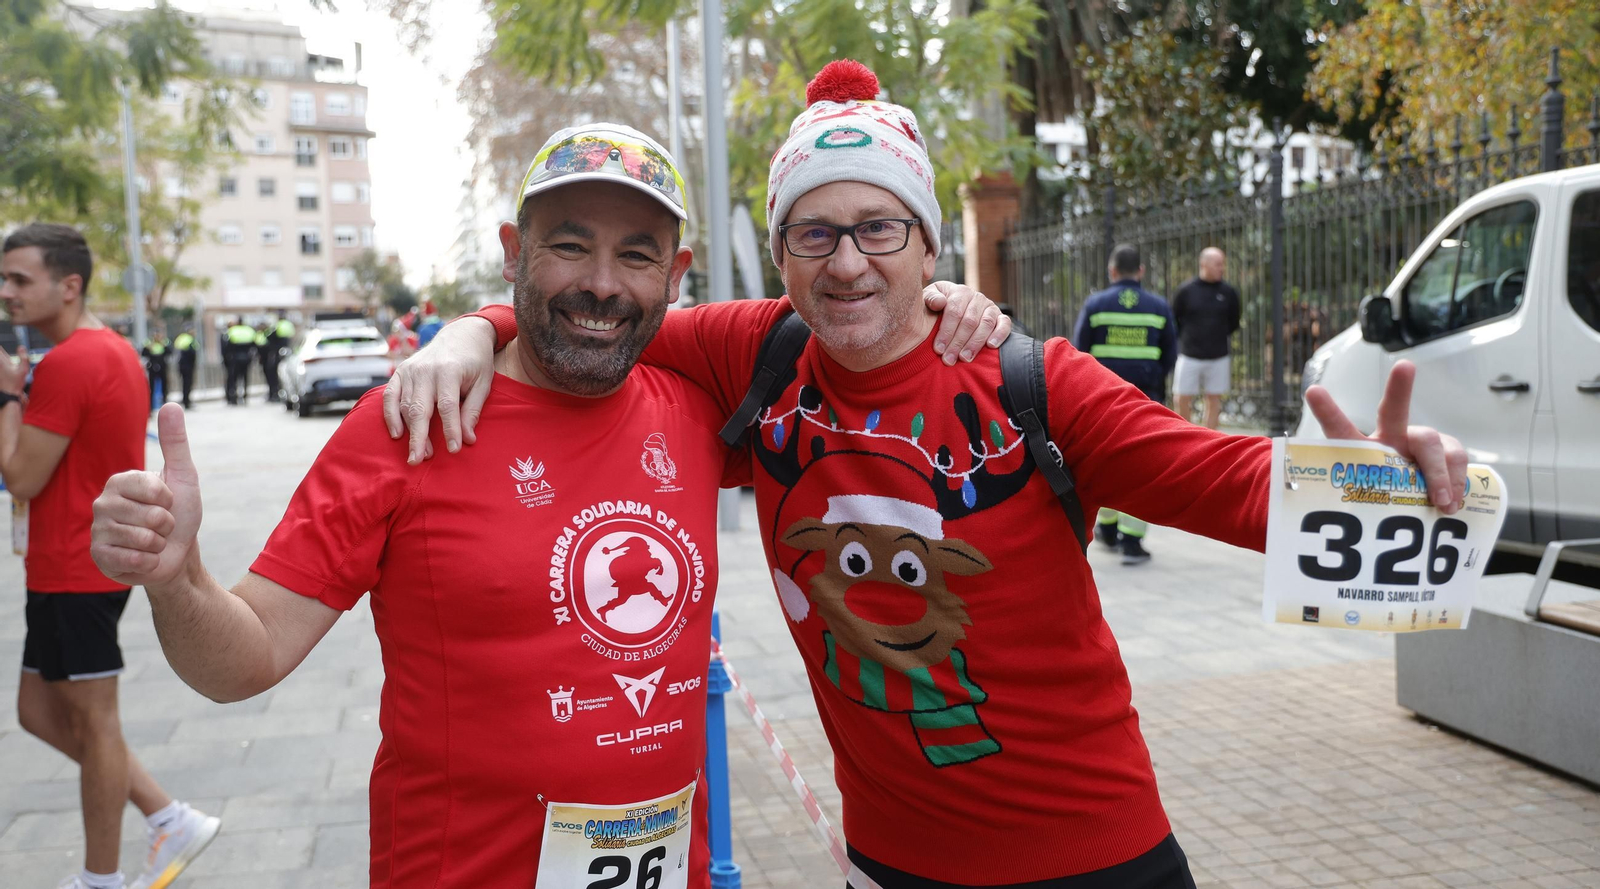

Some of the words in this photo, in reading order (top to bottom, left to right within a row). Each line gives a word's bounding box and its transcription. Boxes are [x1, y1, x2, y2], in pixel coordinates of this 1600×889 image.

[515, 479, 552, 495] UCA
[1331, 462, 1412, 493] CARRERA
[520, 492, 555, 504] Universidad
[535, 499, 553, 507] Cádiz
[1341, 482, 1391, 505] Solidaria
[1391, 495, 1418, 506] CIUDAD
[1470, 492, 1500, 501] CUPRA
[572, 500, 652, 530] SOLIDARIA
[656, 510, 677, 531] DE
[1297, 510, 1469, 586] 326
[549, 526, 578, 603] CARRERA
[677, 528, 705, 603] NAVIDAD
[1337, 587, 1385, 602] NAVARRO
[553, 606, 571, 625] XI
[580, 633, 621, 661] CIUDAD
[624, 651, 641, 662] DE
[642, 616, 688, 660] ALGECIRAS
[666, 676, 701, 696] EVOS
[577, 696, 614, 706] Ayuntamiento
[583, 702, 607, 711] Algeciras
[596, 719, 683, 747] CUPRA
[630, 742, 663, 755] TURIAL
[625, 809, 634, 819] XI
[634, 803, 659, 817] EDICIÓN
[551, 821, 583, 831] EVOS
[584, 819, 643, 841] CARRERA
[590, 834, 626, 849] Solidaria
[651, 825, 677, 842] ALGECIRAS
